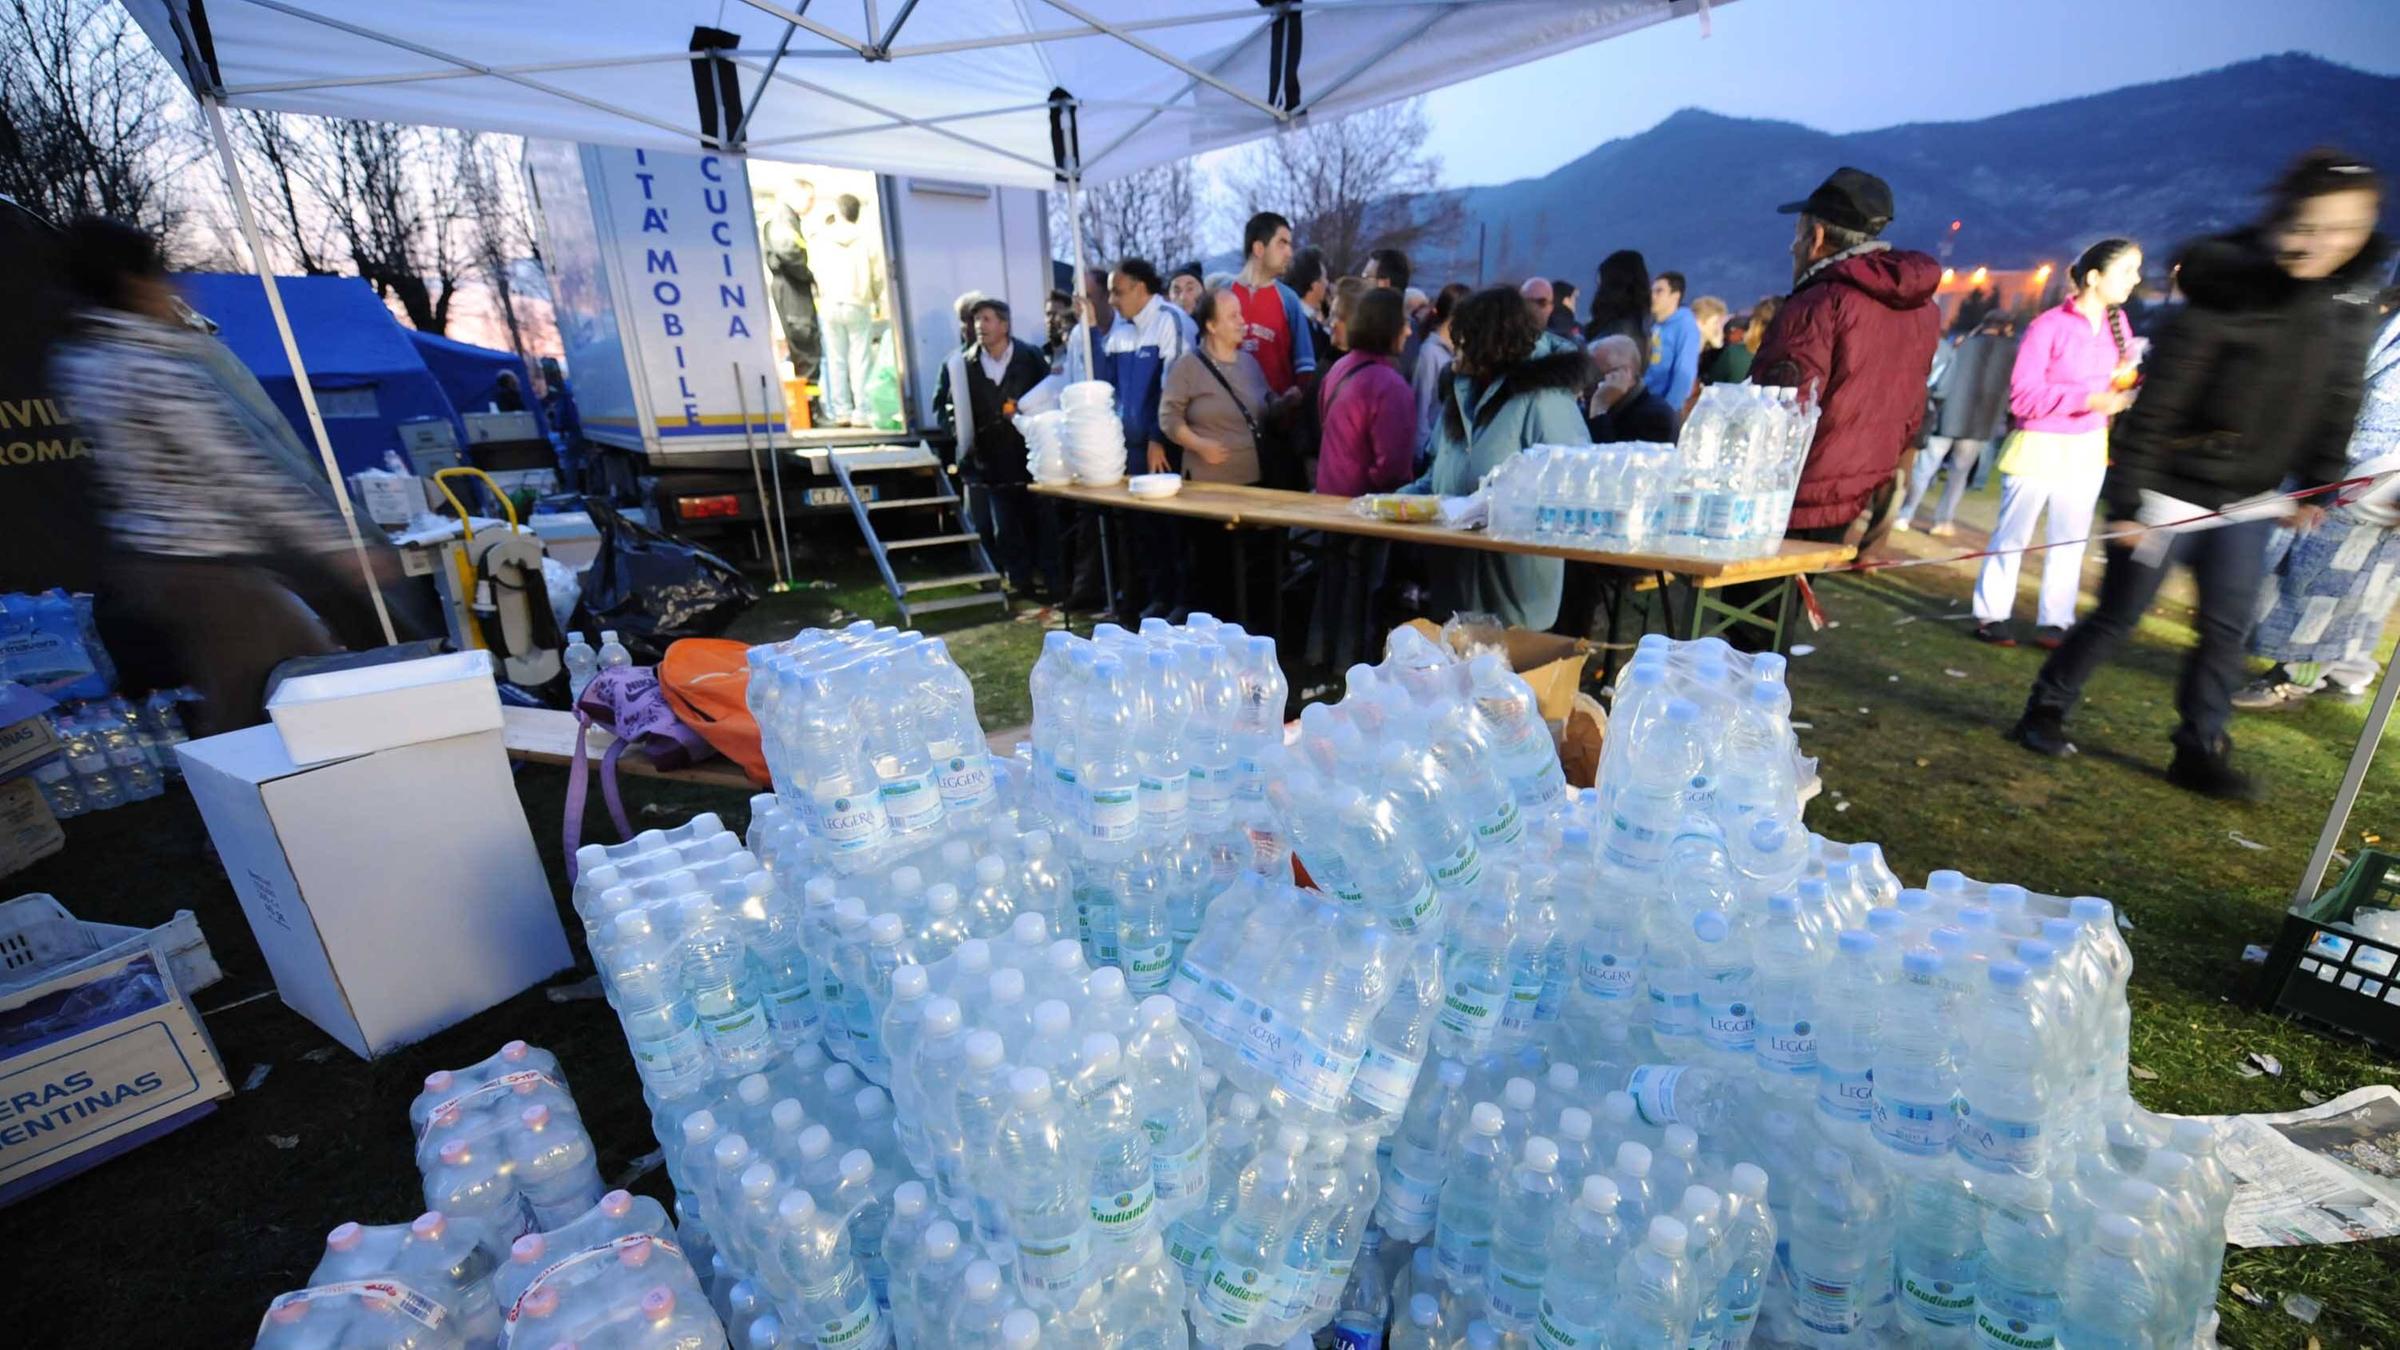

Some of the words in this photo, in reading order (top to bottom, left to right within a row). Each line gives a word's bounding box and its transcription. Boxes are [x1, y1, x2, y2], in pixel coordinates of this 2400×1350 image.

[701, 156, 750, 338] CUCINA
[647, 249, 701, 424] MOBILE
[936, 770, 985, 788] LEGGERA
[821, 811, 875, 830] LEGGERA
[1585, 960, 1632, 981] LEGGERA
[0, 1071, 163, 1147] ENTINAS
